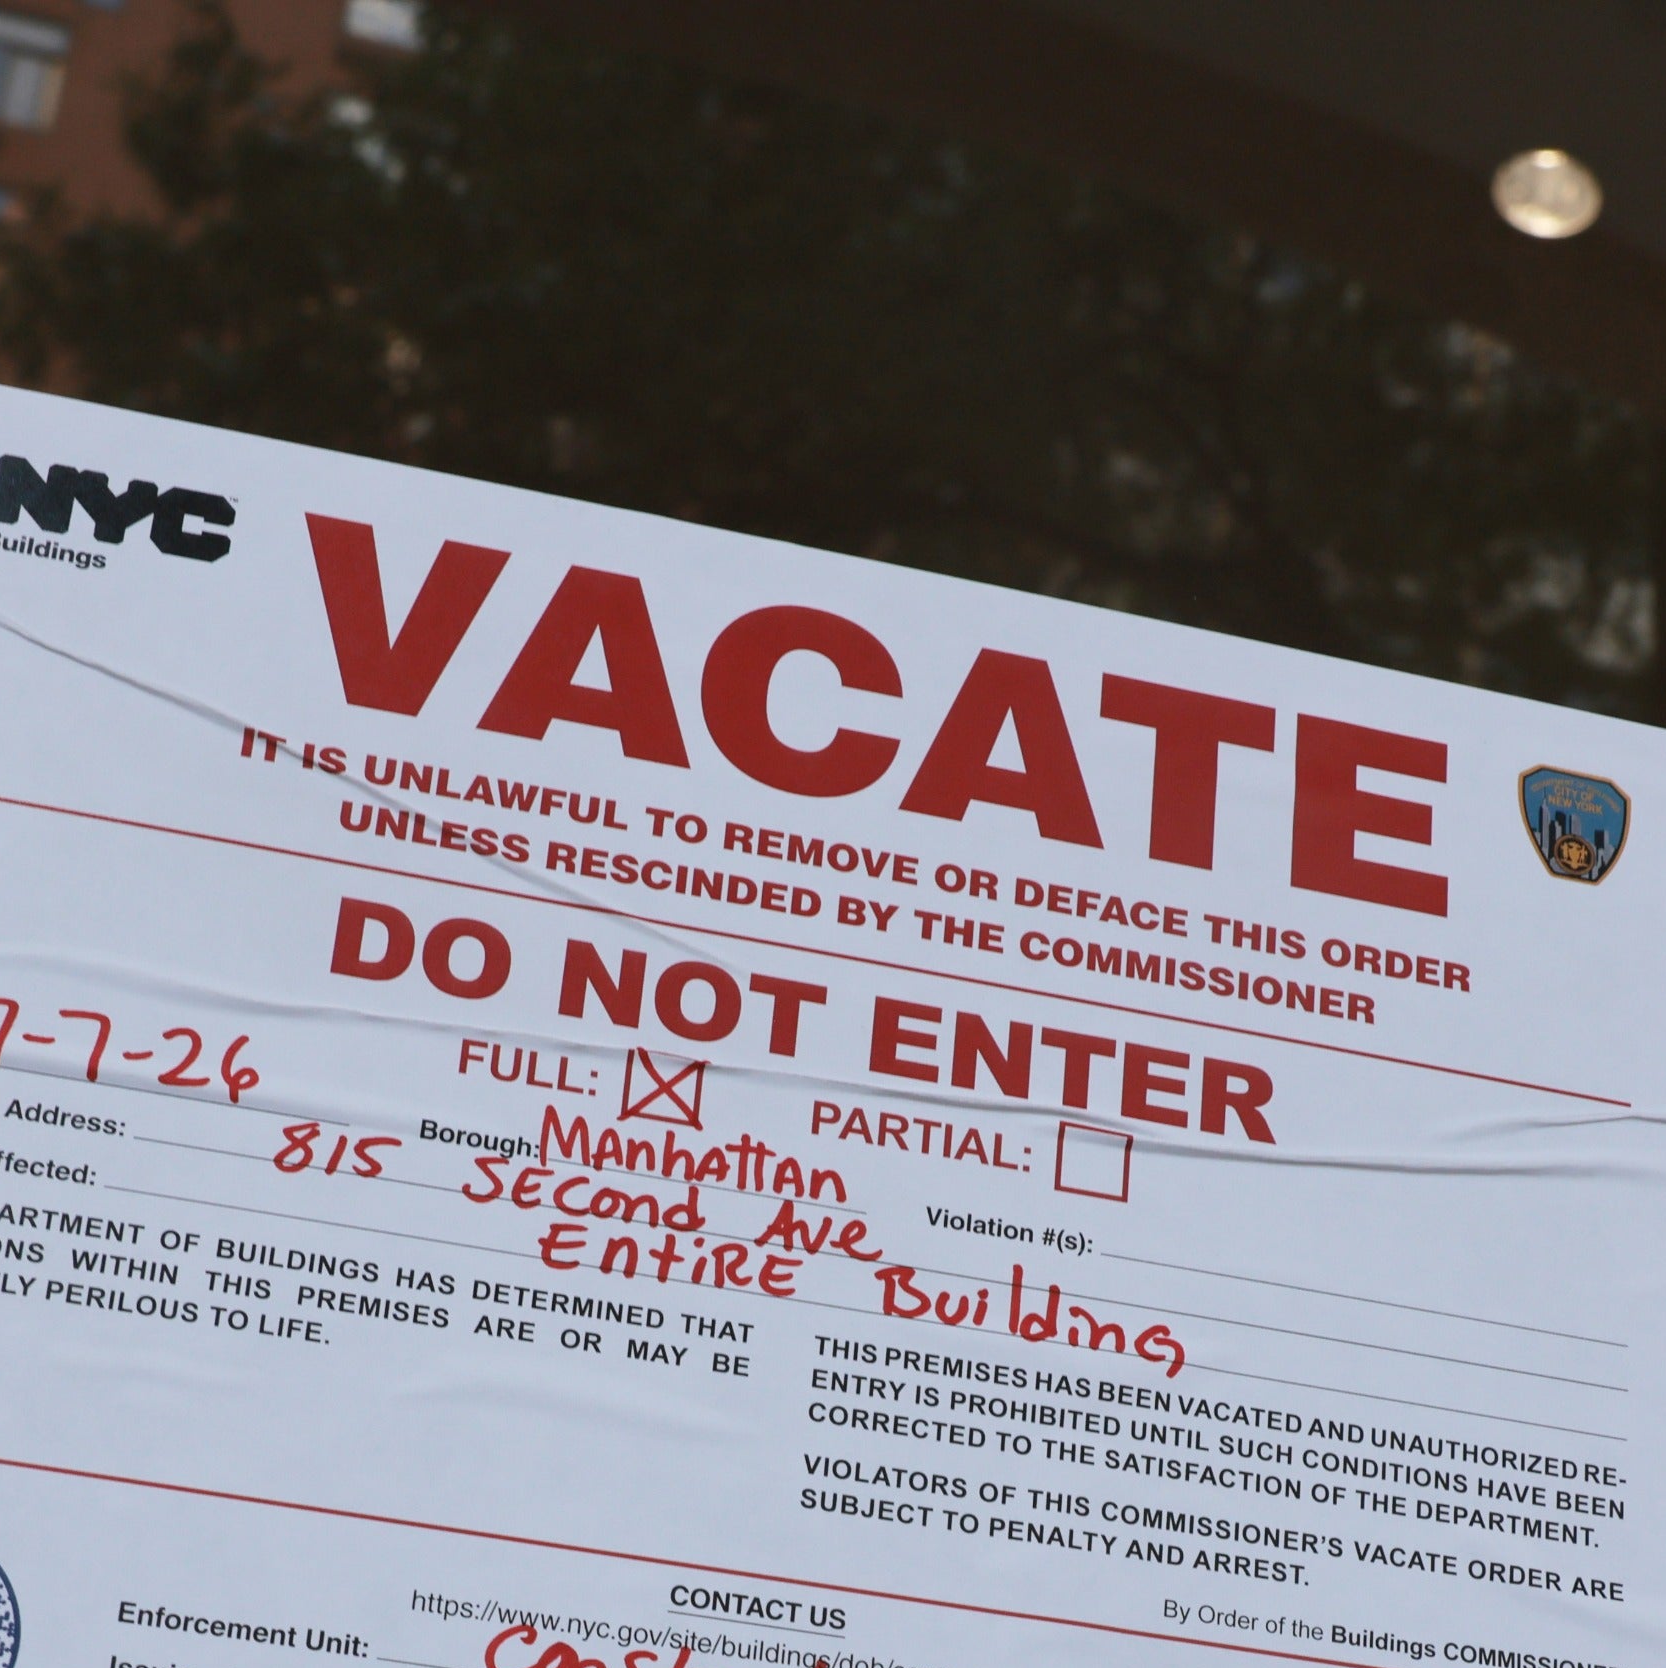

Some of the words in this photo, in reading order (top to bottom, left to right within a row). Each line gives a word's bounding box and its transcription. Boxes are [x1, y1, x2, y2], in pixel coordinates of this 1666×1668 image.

[306, 513, 1448, 916] VACATE
[1548, 794, 1572, 808] NEW
[1575, 799, 1603, 815] YORK
[242, 729, 284, 761] IT
[304, 744, 345, 772] IS
[365, 756, 626, 829] UNLAWFUL
[647, 808, 707, 843] TO
[725, 823, 918, 884] REMOVE
[936, 864, 997, 899] OR
[1016, 879, 1187, 935] DEFACE
[1206, 915, 1305, 958] THIS
[1323, 939, 1469, 991] ORDER
[341, 802, 528, 862] UNLESS
[547, 842, 821, 916] RESCINDED
[839, 896, 897, 930] BY
[916, 911, 1004, 952] THE
[1021, 932, 1373, 1023] COMMISSIONER
[331, 897, 511, 999] DO
[559, 940, 827, 1056] NOT
[870, 997, 1274, 1143] ENTER
[460, 1040, 597, 1095] FULL:
[4, 1099, 125, 1136] Address:
[274, 1122, 401, 1177] 815
[420, 1119, 539, 1159] Borough:
[813, 1101, 1030, 1170] PARTIAL:
[926, 1206, 1033, 1243] Violation
[1042, 1228, 1092, 1256] #(s):
[46, 1280, 198, 1323] PERILOUS
[211, 1306, 248, 1330] TO
[259, 1314, 329, 1344] LIFE.
[72, 1249, 178, 1285] WITHIN
[206, 1271, 270, 1299] THIS
[298, 1286, 448, 1328] PREMISES
[474, 1315, 535, 1342] ARE
[561, 1329, 601, 1353] OR
[627, 1339, 688, 1366] MAY
[712, 1353, 749, 1377] BE
[160, 1230, 200, 1252] OF
[216, 1238, 378, 1282] BUILDINGS
[396, 1267, 455, 1295] HAS
[472, 1280, 664, 1328] DETERMINED
[681, 1313, 754, 1343] THAT
[812, 1369, 906, 1401] ENTRY
[915, 1385, 939, 1407] IS
[951, 1391, 1120, 1436] PROHIBITED
[1131, 1420, 1209, 1451] UNTIL
[1219, 1435, 1292, 1465] SUCH
[1303, 1449, 1467, 1493] CONDITIONS
[1478, 1477, 1546, 1507] HAVE
[1556, 1491, 1624, 1520] BEEN
[815, 1335, 877, 1364] THIS
[885, 1347, 1027, 1388] PREMISES
[1035, 1371, 1090, 1398] HAS
[1098, 1381, 1170, 1412] BEEN
[1178, 1395, 1302, 1433] VACATED
[1308, 1418, 1364, 1443] AND
[1371, 1428, 1577, 1479] UNAUTHORIZED
[1585, 1464, 1626, 1487] RE-
[809, 1402, 985, 1447] CORRECTED
[996, 1432, 1031, 1455] TO
[1042, 1439, 1095, 1465] THE
[1105, 1450, 1301, 1499] SATISFACTION
[1311, 1484, 1346, 1505] OF
[1356, 1490, 1406, 1516] THE
[1417, 1500, 1598, 1548] DEPARTMENT.
[801, 1489, 933, 1527] SUBJECT
[943, 1510, 979, 1534] TO
[989, 1517, 1117, 1555] PENALTY
[1125, 1540, 1184, 1565] AND
[1193, 1550, 1308, 1586] ARREST.
[804, 1454, 967, 1498] VIOLATORS
[979, 1483, 1016, 1505] OF
[1028, 1489, 1089, 1516] THIS
[1354, 1541, 1457, 1576] VACATE
[1468, 1560, 1561, 1591] ORDER
[1572, 1577, 1624, 1601] ARE
[118, 1601, 297, 1647] Enforcement
[306, 1629, 368, 1658] Unit:
[671, 1585, 802, 1623] CONTACT
[810, 1605, 845, 1630] US
[1164, 1599, 1190, 1624] By
[1198, 1605, 1258, 1630] Order
[1266, 1617, 1286, 1634] of
[1292, 1620, 1323, 1640] the
[1332, 1625, 1435, 1660] Buildings
